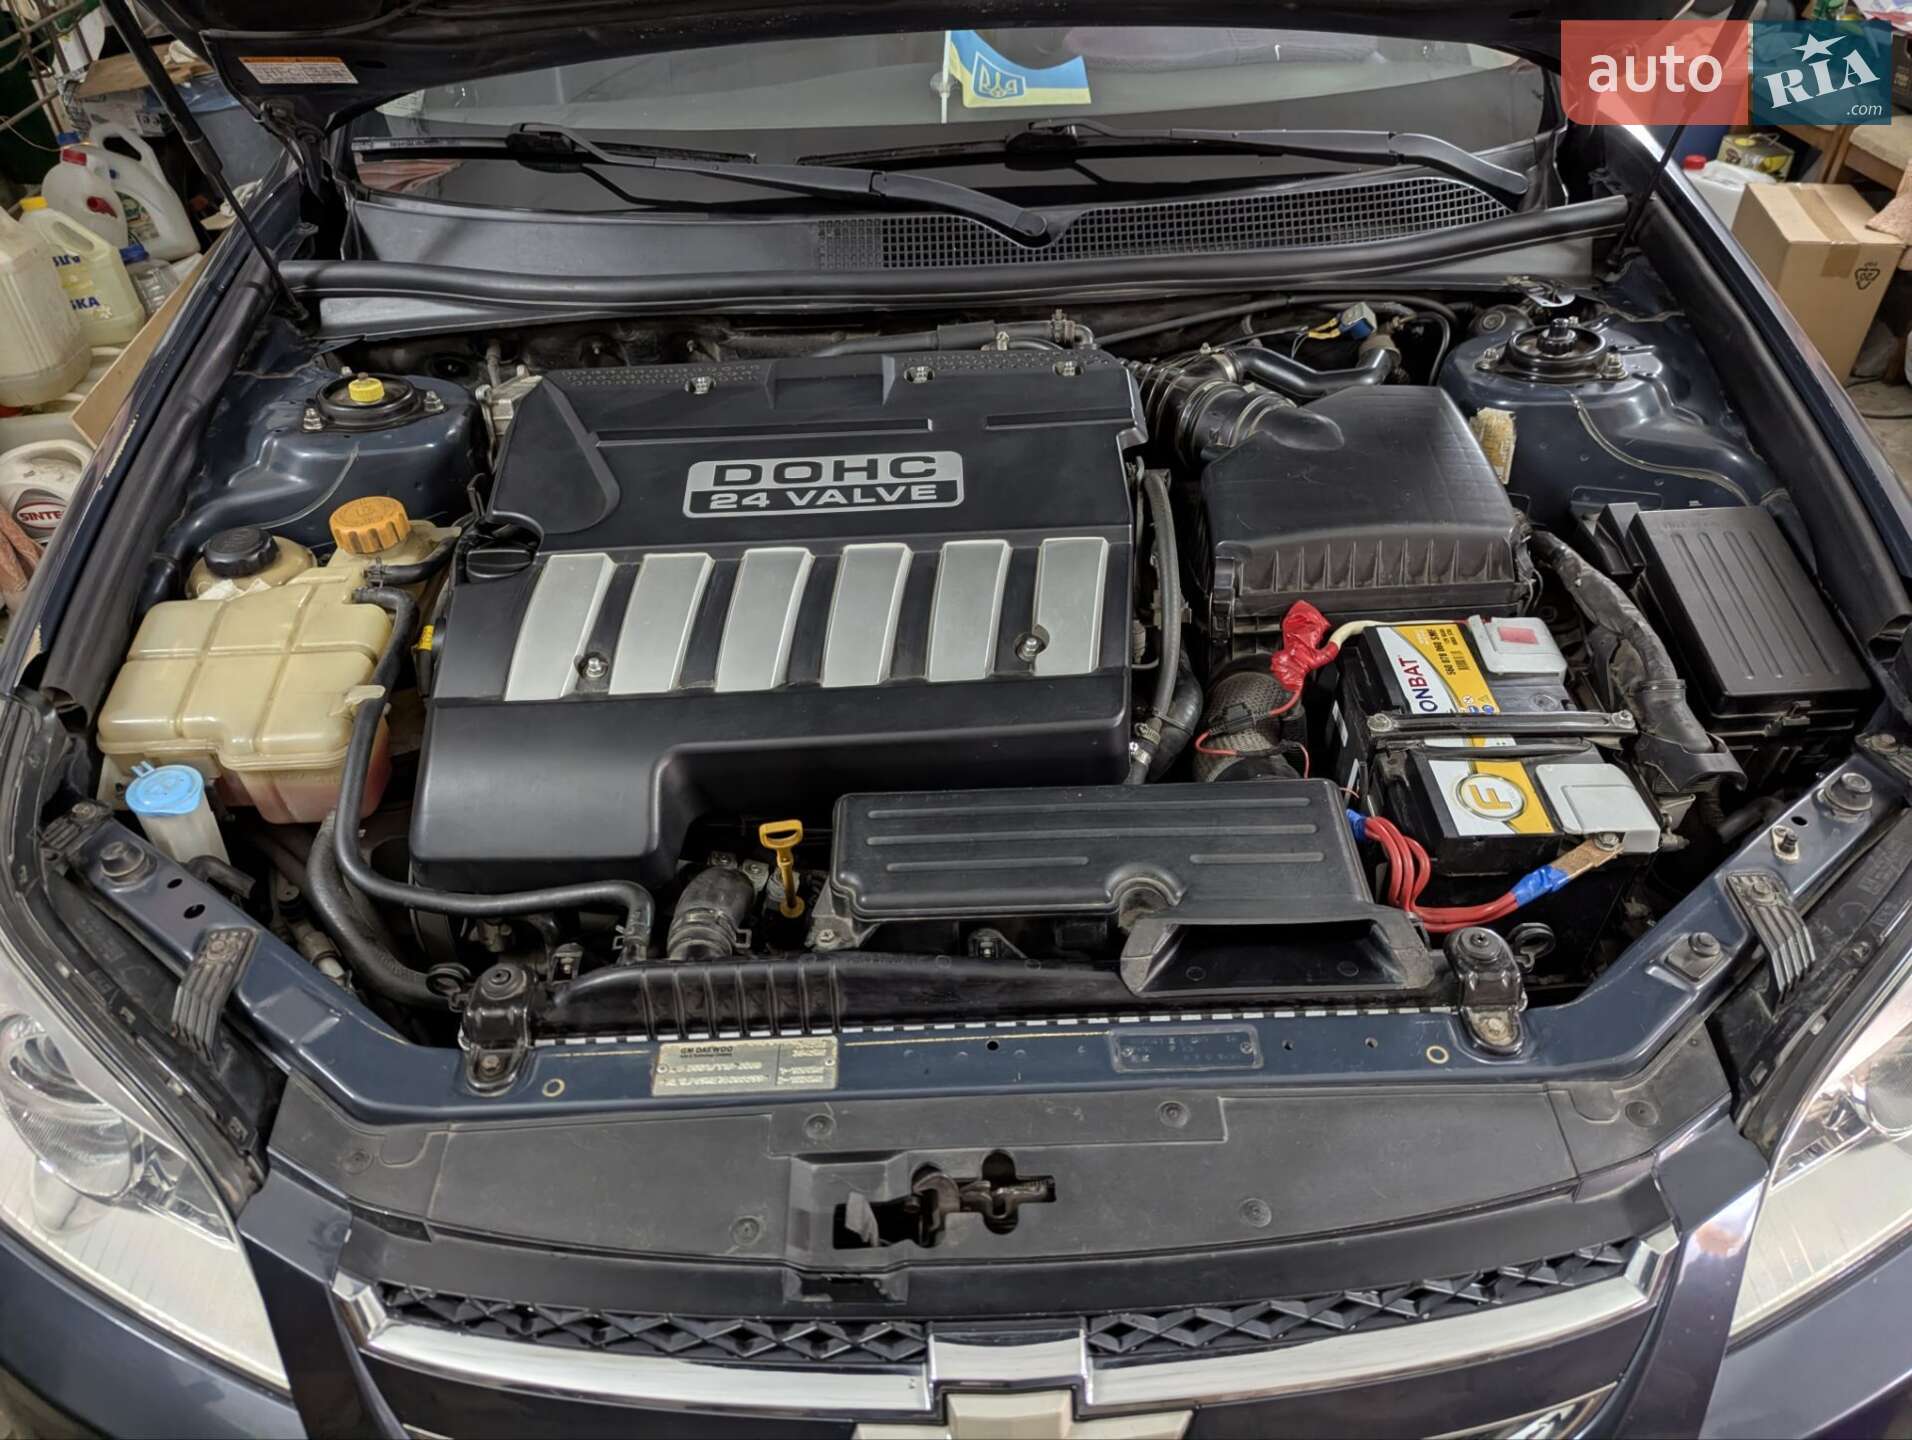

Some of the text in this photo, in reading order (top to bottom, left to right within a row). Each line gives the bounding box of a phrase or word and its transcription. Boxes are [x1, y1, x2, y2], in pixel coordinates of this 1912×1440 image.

[712, 455, 937, 487] DOHC
[709, 484, 938, 510] 24 VALVE
